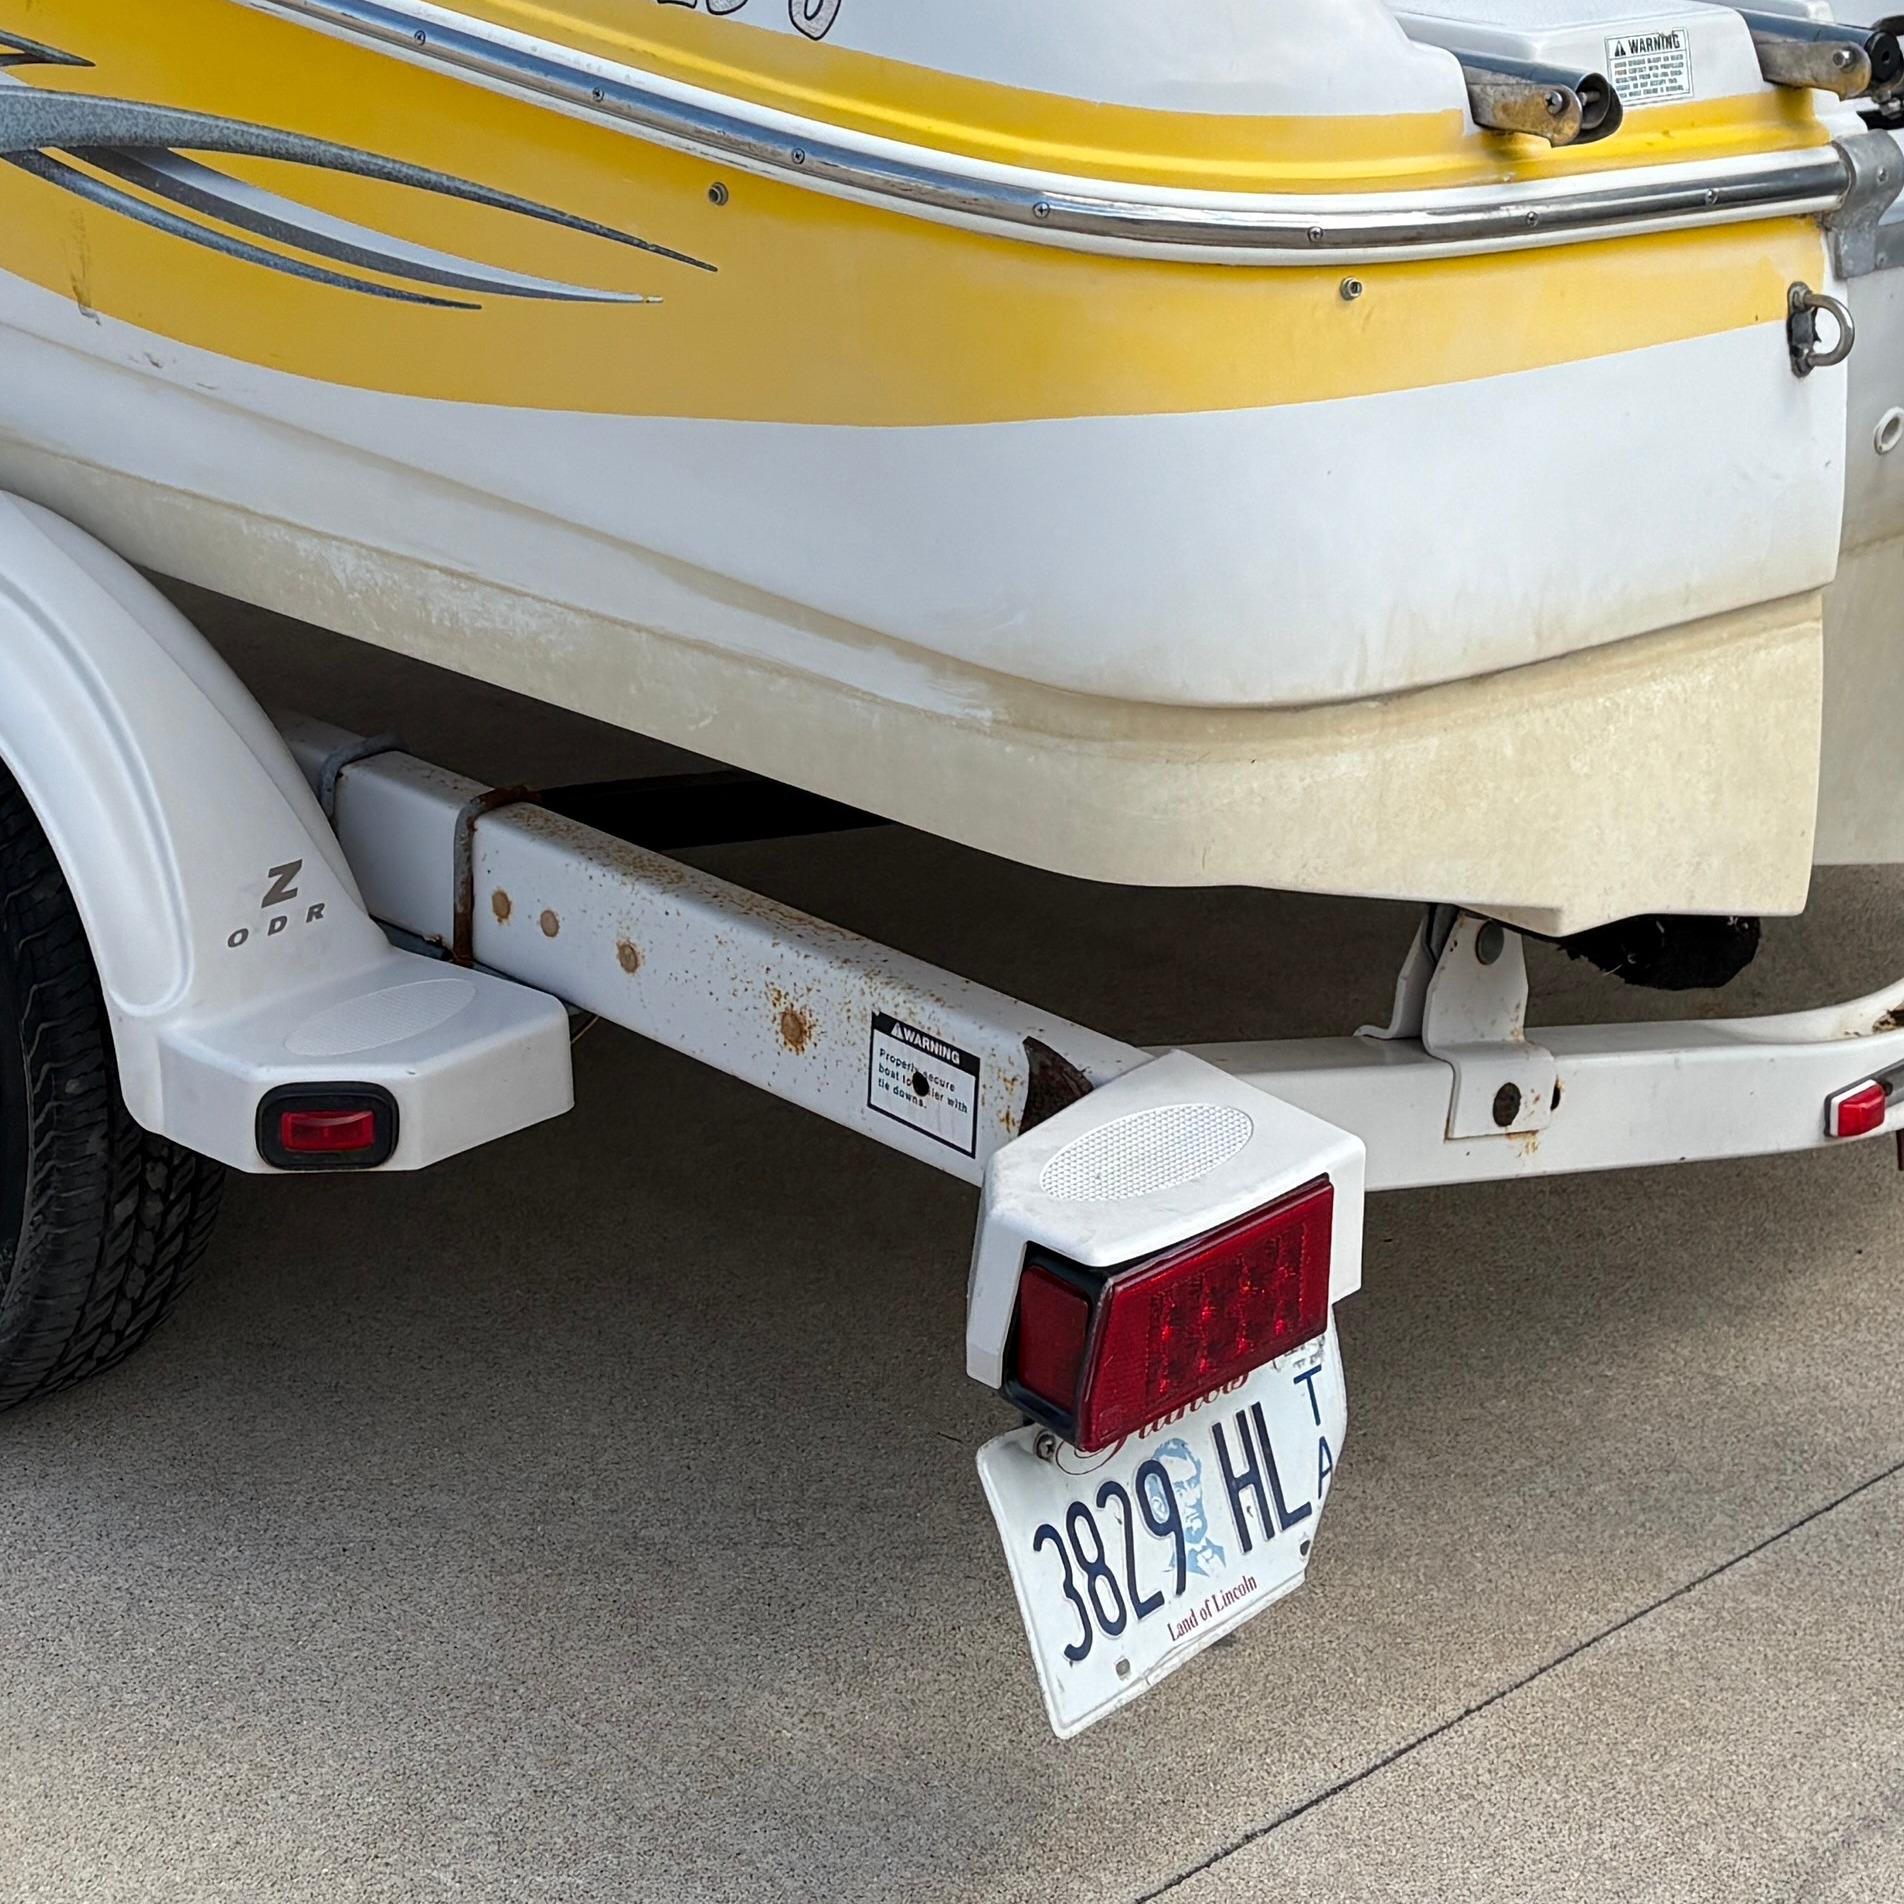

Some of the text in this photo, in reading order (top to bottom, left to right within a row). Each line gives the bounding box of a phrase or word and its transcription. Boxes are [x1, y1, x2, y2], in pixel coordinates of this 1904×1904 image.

[1628, 34, 1680, 54] WARNING
[261, 859, 303, 908] Z
[903, 1027, 960, 1065] WARNING
[878, 1063, 899, 1081] boat
[903, 1074, 912, 1087] to
[947, 1097, 967, 1114] with
[878, 1077, 927, 1109] tie downs.
[923, 1071, 955, 1092] secure
[1033, 1401, 1312, 1663] 3829 HL
[1167, 1576, 1258, 1642] Land of Lincoln
